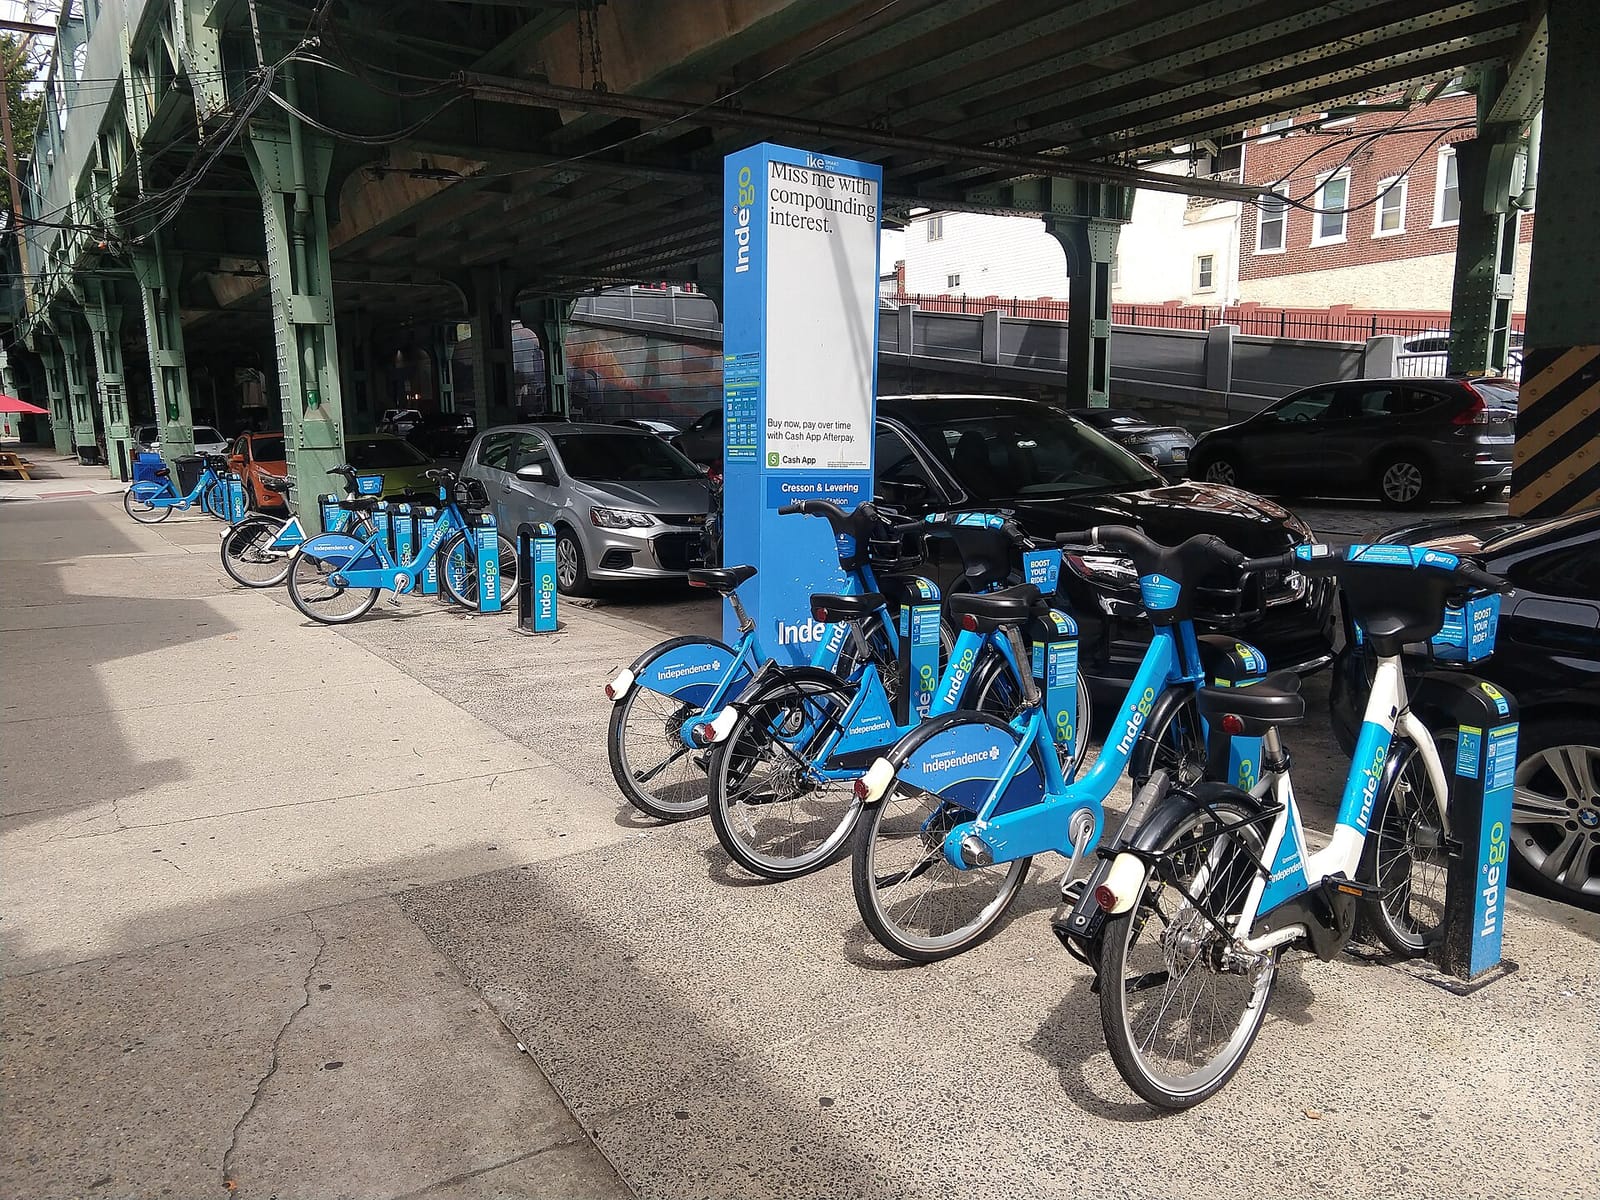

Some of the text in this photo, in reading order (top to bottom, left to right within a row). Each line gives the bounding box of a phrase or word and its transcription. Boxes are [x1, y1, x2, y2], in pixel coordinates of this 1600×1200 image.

[806, 153, 825, 169] ike
[771, 161, 871, 196] Miss me with
[770, 187, 876, 222] compounding
[735, 166, 755, 274] Indego
[770, 206, 833, 233] interest.
[767, 418, 782, 429] Buy
[784, 420, 801, 429] now,
[803, 421, 816, 430] pay
[835, 421, 852, 430] time
[767, 431, 855, 444] with Cash App Afterpay.
[782, 455, 816, 465] Cash App
[781, 482, 859, 493] Cresson & Levering
[428, 520, 450, 550] Indego
[427, 554, 437, 583] Inde
[485, 560, 497, 600] Indego
[1030, 568, 1047, 576] YOUR
[540, 575, 554, 619] Indego
[1473, 607, 1492, 621] BOOST
[1473, 620, 1489, 632] YOUR
[778, 618, 826, 645] Inde
[825, 620, 847, 654] Inde
[657, 663, 712, 681] Independence
[943, 648, 973, 705] Indego
[916, 665, 935, 718] dego
[1116, 687, 1154, 756] Indego
[922, 750, 989, 774] Independence
[1356, 746, 1385, 828] Indego
[1481, 821, 1506, 937] Indego
